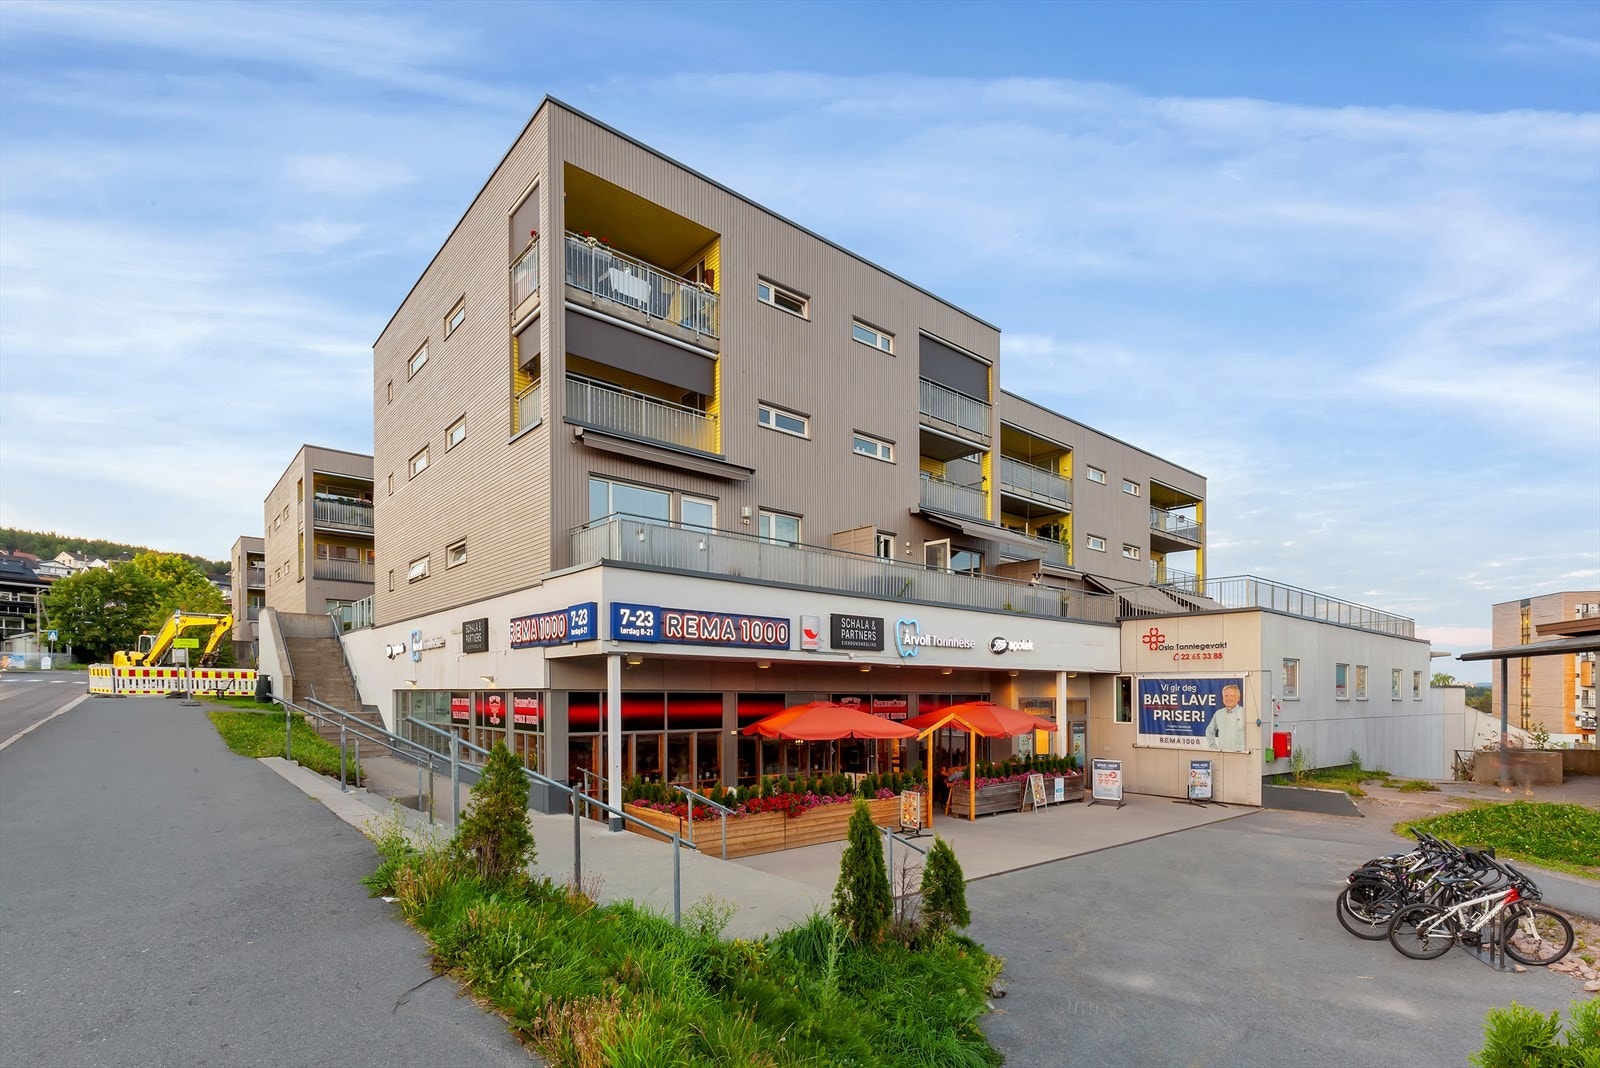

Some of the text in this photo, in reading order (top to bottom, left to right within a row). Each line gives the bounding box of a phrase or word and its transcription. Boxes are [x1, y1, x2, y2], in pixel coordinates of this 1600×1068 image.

[571, 609, 588, 626] 7-23
[620, 608, 654, 627] 7-23
[841, 617, 876, 630] SCHALA &
[509, 613, 567, 643] REMA 1000
[640, 628, 654, 636] 8-21
[666, 613, 788, 644] REMA 1000
[841, 629, 877, 641] PARTNERS
[904, 629, 931, 646] Årvoll
[932, 635, 976, 649] Tannhelse
[1008, 639, 1034, 652] apotek
[1158, 642, 1228, 652] Oslo Tannlegevakt
[1213, 652, 1223, 660] 88
[1170, 684, 1181, 693] gir
[1182, 684, 1197, 693] deg
[1143, 694, 1217, 706] BARE LAVE
[1153, 710, 1205, 722] PRISER!
